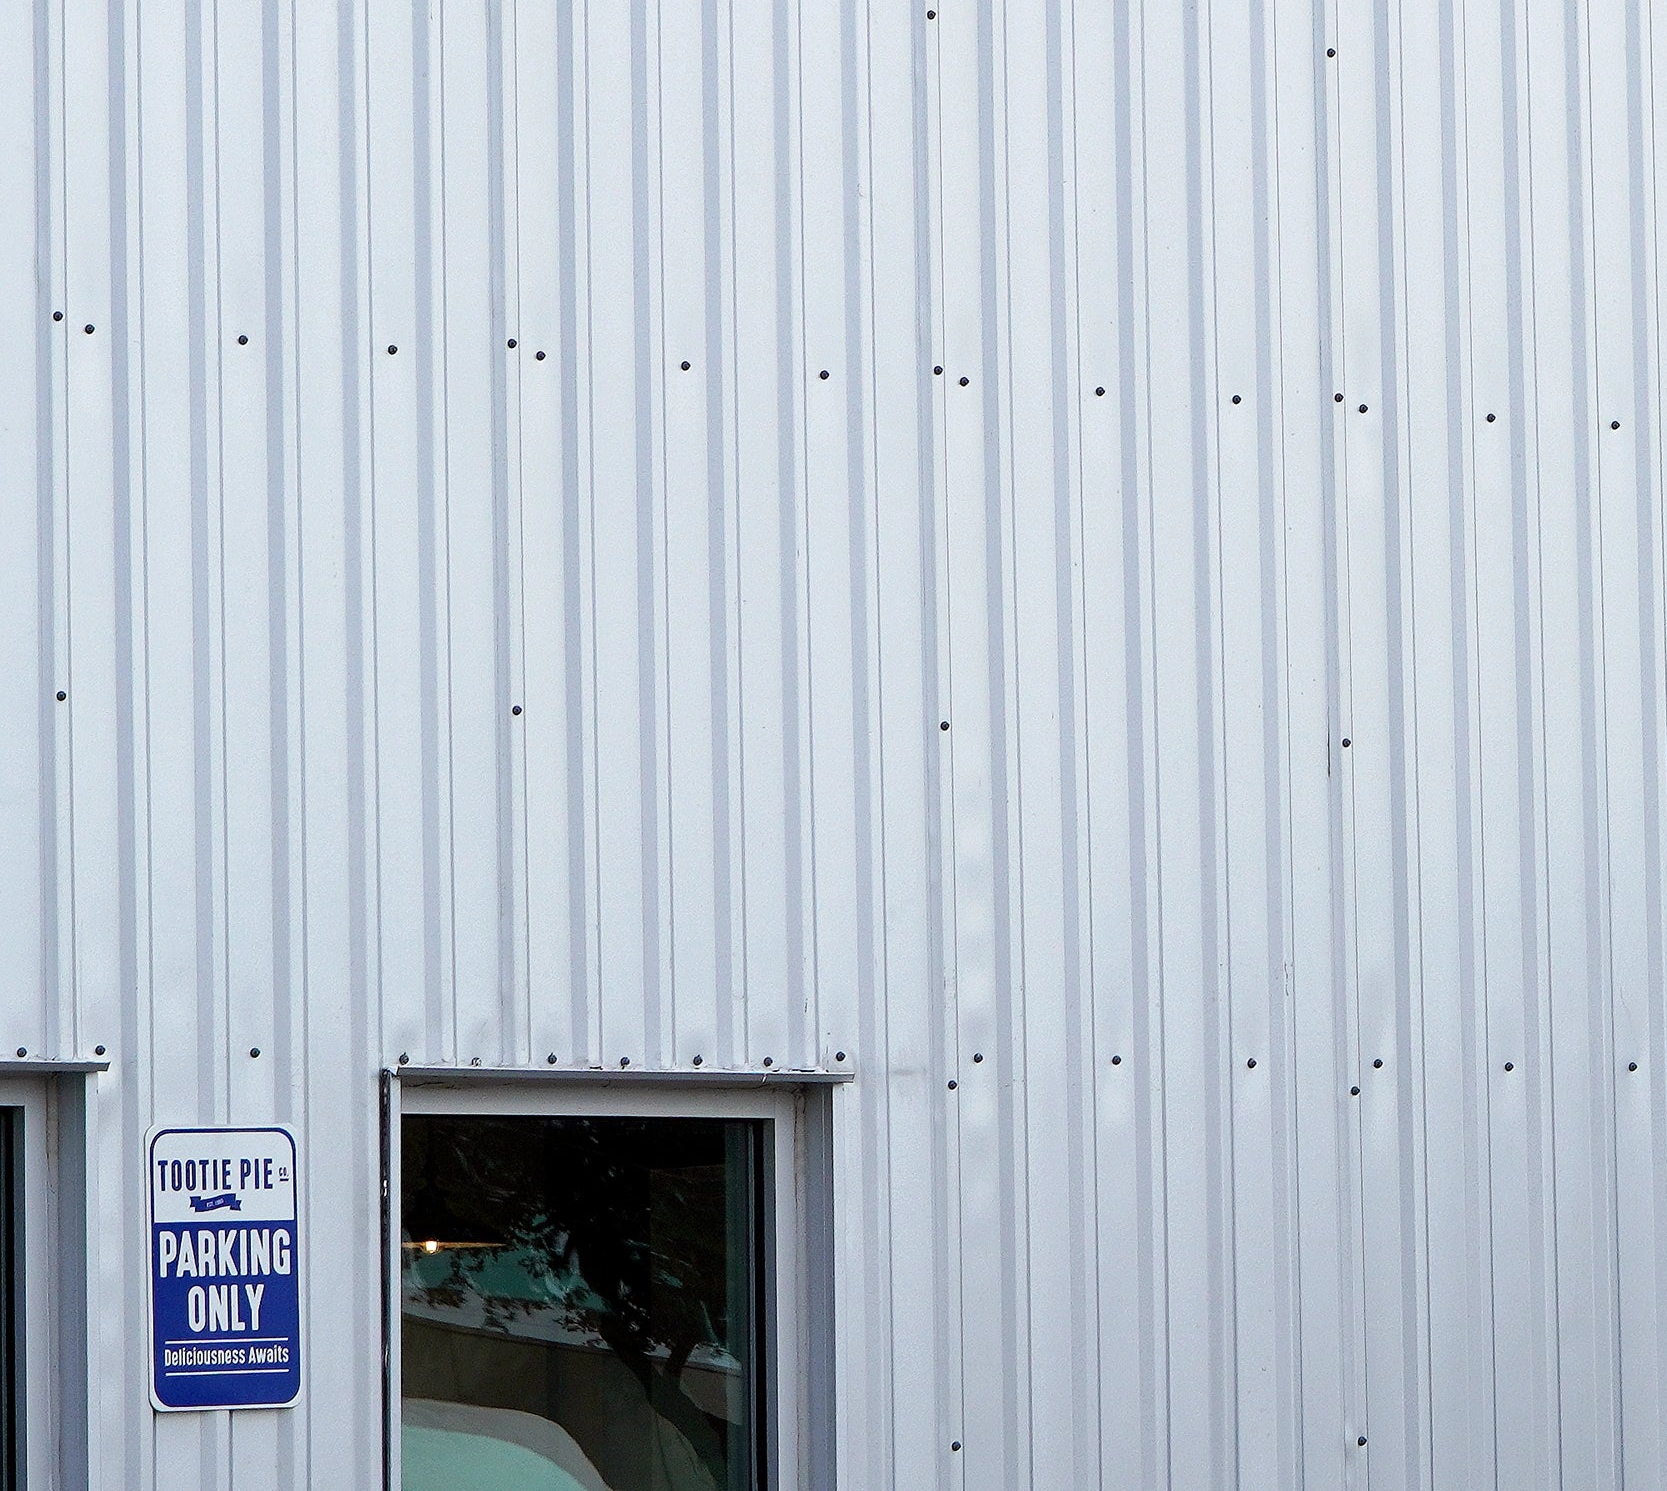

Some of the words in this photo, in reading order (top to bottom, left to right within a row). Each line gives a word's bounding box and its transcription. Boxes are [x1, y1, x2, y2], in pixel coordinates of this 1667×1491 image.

[158, 1159, 232, 1191] TOOTIE
[240, 1158, 273, 1190] PIE
[159, 1228, 291, 1278] PARKING
[188, 1283, 265, 1333] ONLY
[164, 1347, 246, 1366] Deliciousness
[248, 1345, 289, 1364] Awaits
